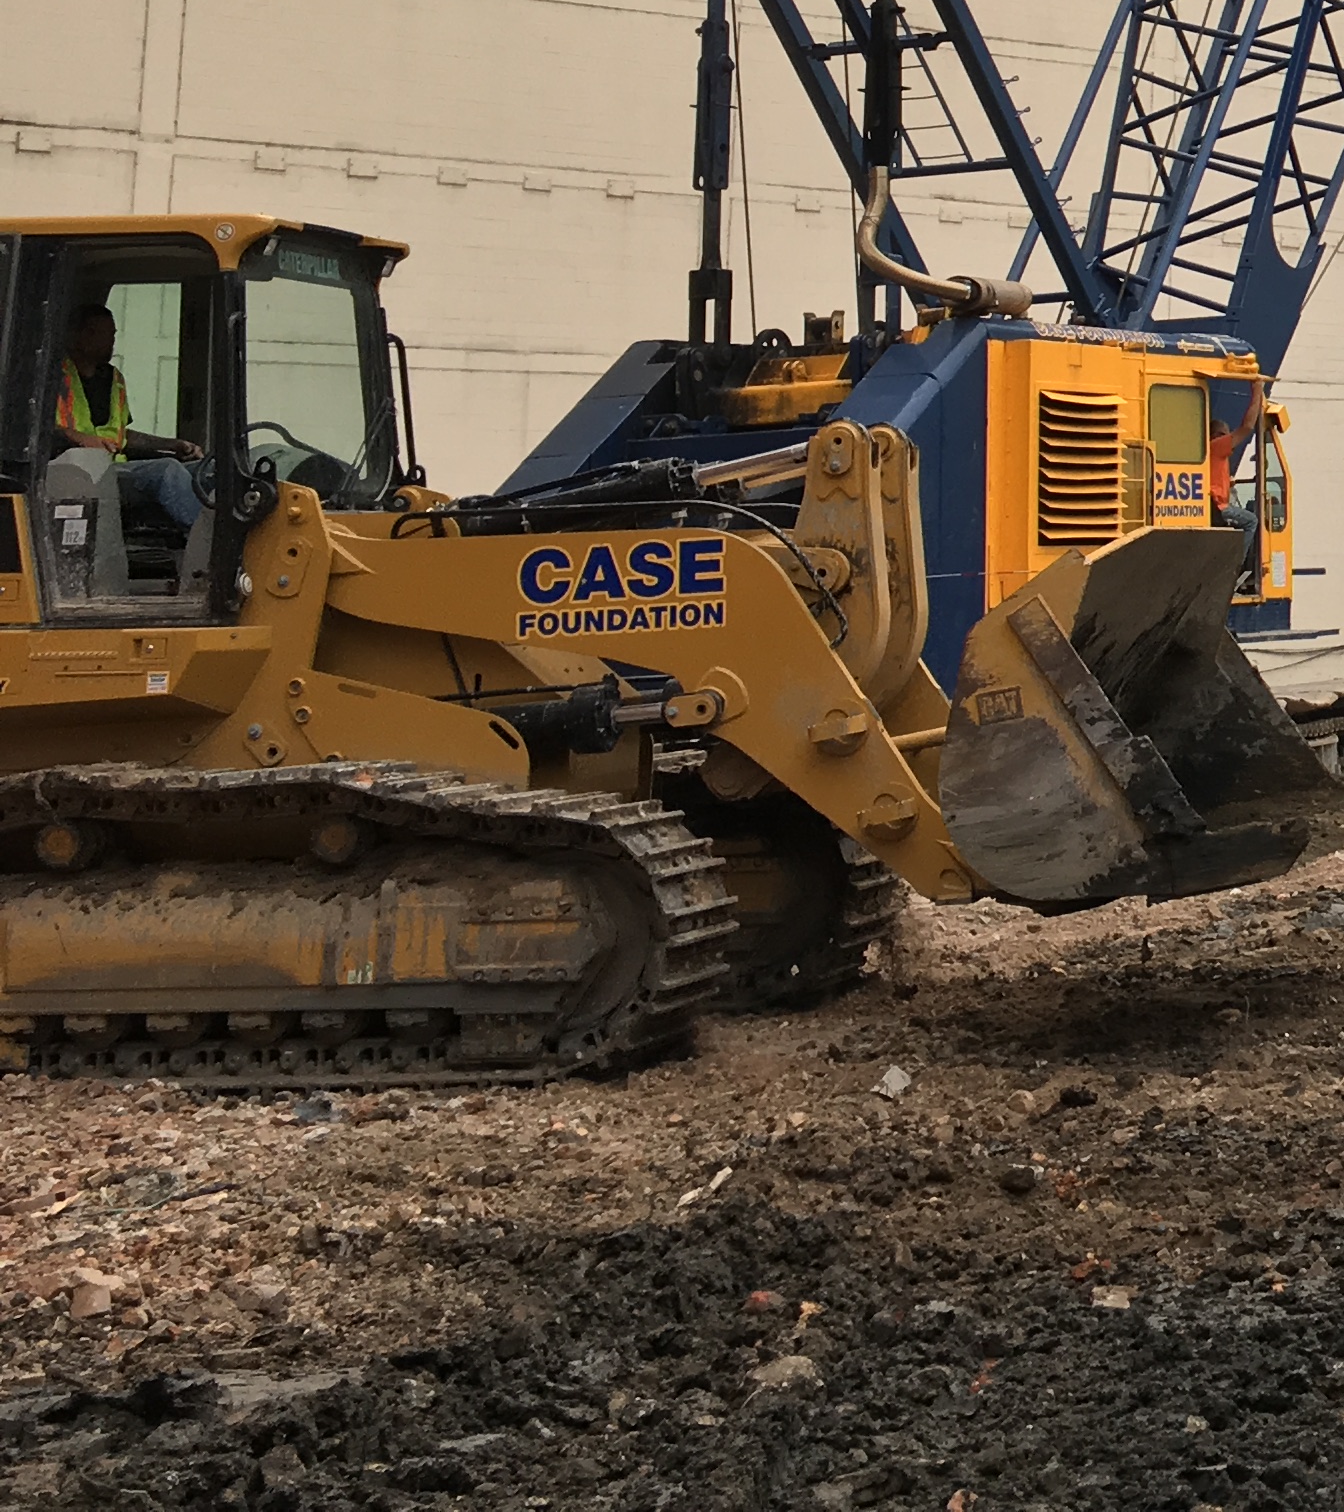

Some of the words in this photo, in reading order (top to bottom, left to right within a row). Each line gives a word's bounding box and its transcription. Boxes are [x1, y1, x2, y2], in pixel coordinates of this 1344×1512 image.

[1155, 505, 1204, 518] OUNDATION
[518, 538, 726, 605] CASE
[518, 601, 726, 638] FOUNDATION
